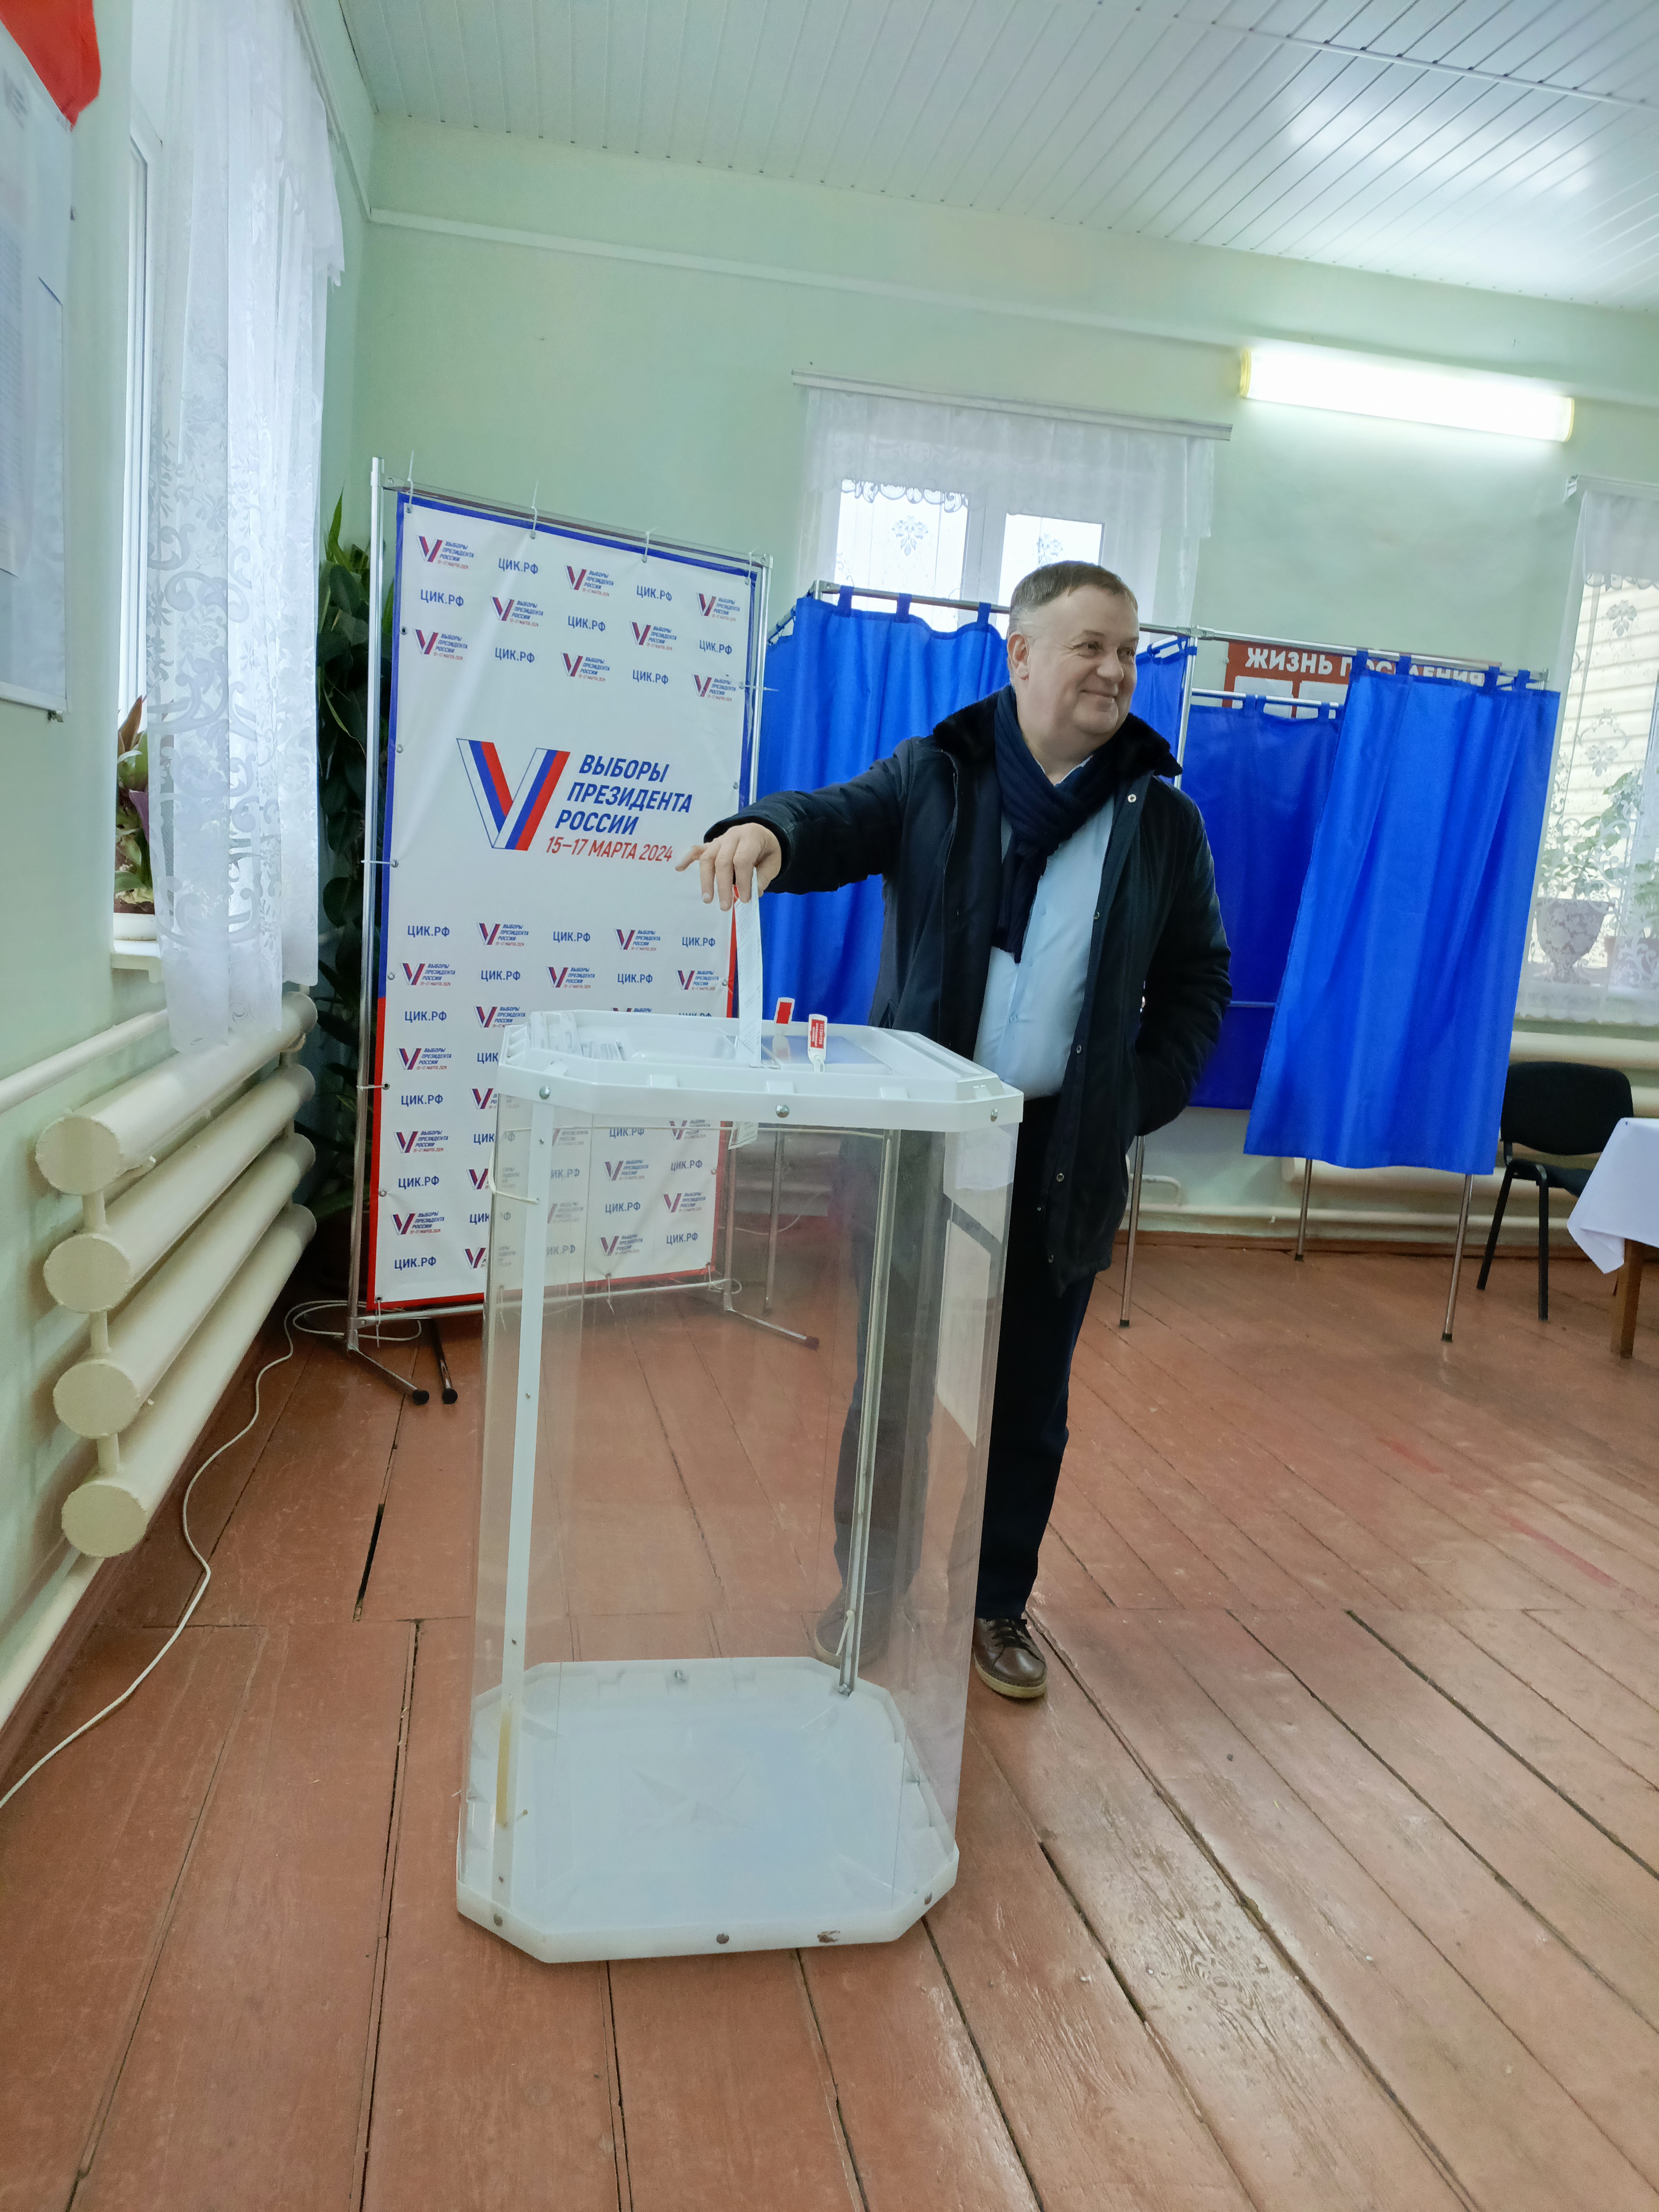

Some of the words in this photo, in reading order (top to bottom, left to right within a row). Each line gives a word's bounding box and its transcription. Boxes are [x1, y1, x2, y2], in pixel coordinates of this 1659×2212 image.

[498, 558, 539, 575] ЦИК.РФ
[421, 589, 464, 607] ЦИК.РФ
[636, 585, 672, 602] ЦИК.РФ
[568, 615, 606, 632] ЦИК.РФ
[699, 639, 733, 655] ЦИК.РФ
[495, 647, 535, 663] ЦИК.РФ
[1245, 648, 1334, 674] ЖИЗНЬ
[632, 669, 669, 685] ЦИК.РФ
[579, 754, 670, 783] ВЫБОРЫ
[566, 781, 693, 813] ПРЕЗИДЕНТА
[554, 809, 639, 836] РОССИИ
[589, 840, 639, 860] МАРТА
[638, 844, 673, 863] 2024
[408, 925, 450, 938] ЦИК.РФ
[553, 931, 591, 943] ЦИК.РФ
[682, 937, 716, 948] ЦИК.РФ
[481, 970, 521, 982] ЦИК.РФ
[617, 974, 653, 985] ЦИК.РФ
[405, 1010, 447, 1023] ЦИК.РФ
[401, 1094, 444, 1107] ЦИК.РФ
[609, 1128, 645, 1139] ЦИК.РФ
[671, 1159, 703, 1172] ЦИК.РФ
[398, 1175, 440, 1190] ЦИК.РФ
[605, 1201, 641, 1214] ЦИК.РФ
[666, 1232, 698, 1246] ЦИК.РФ
[394, 1256, 437, 1271] ЦИК.РФ
